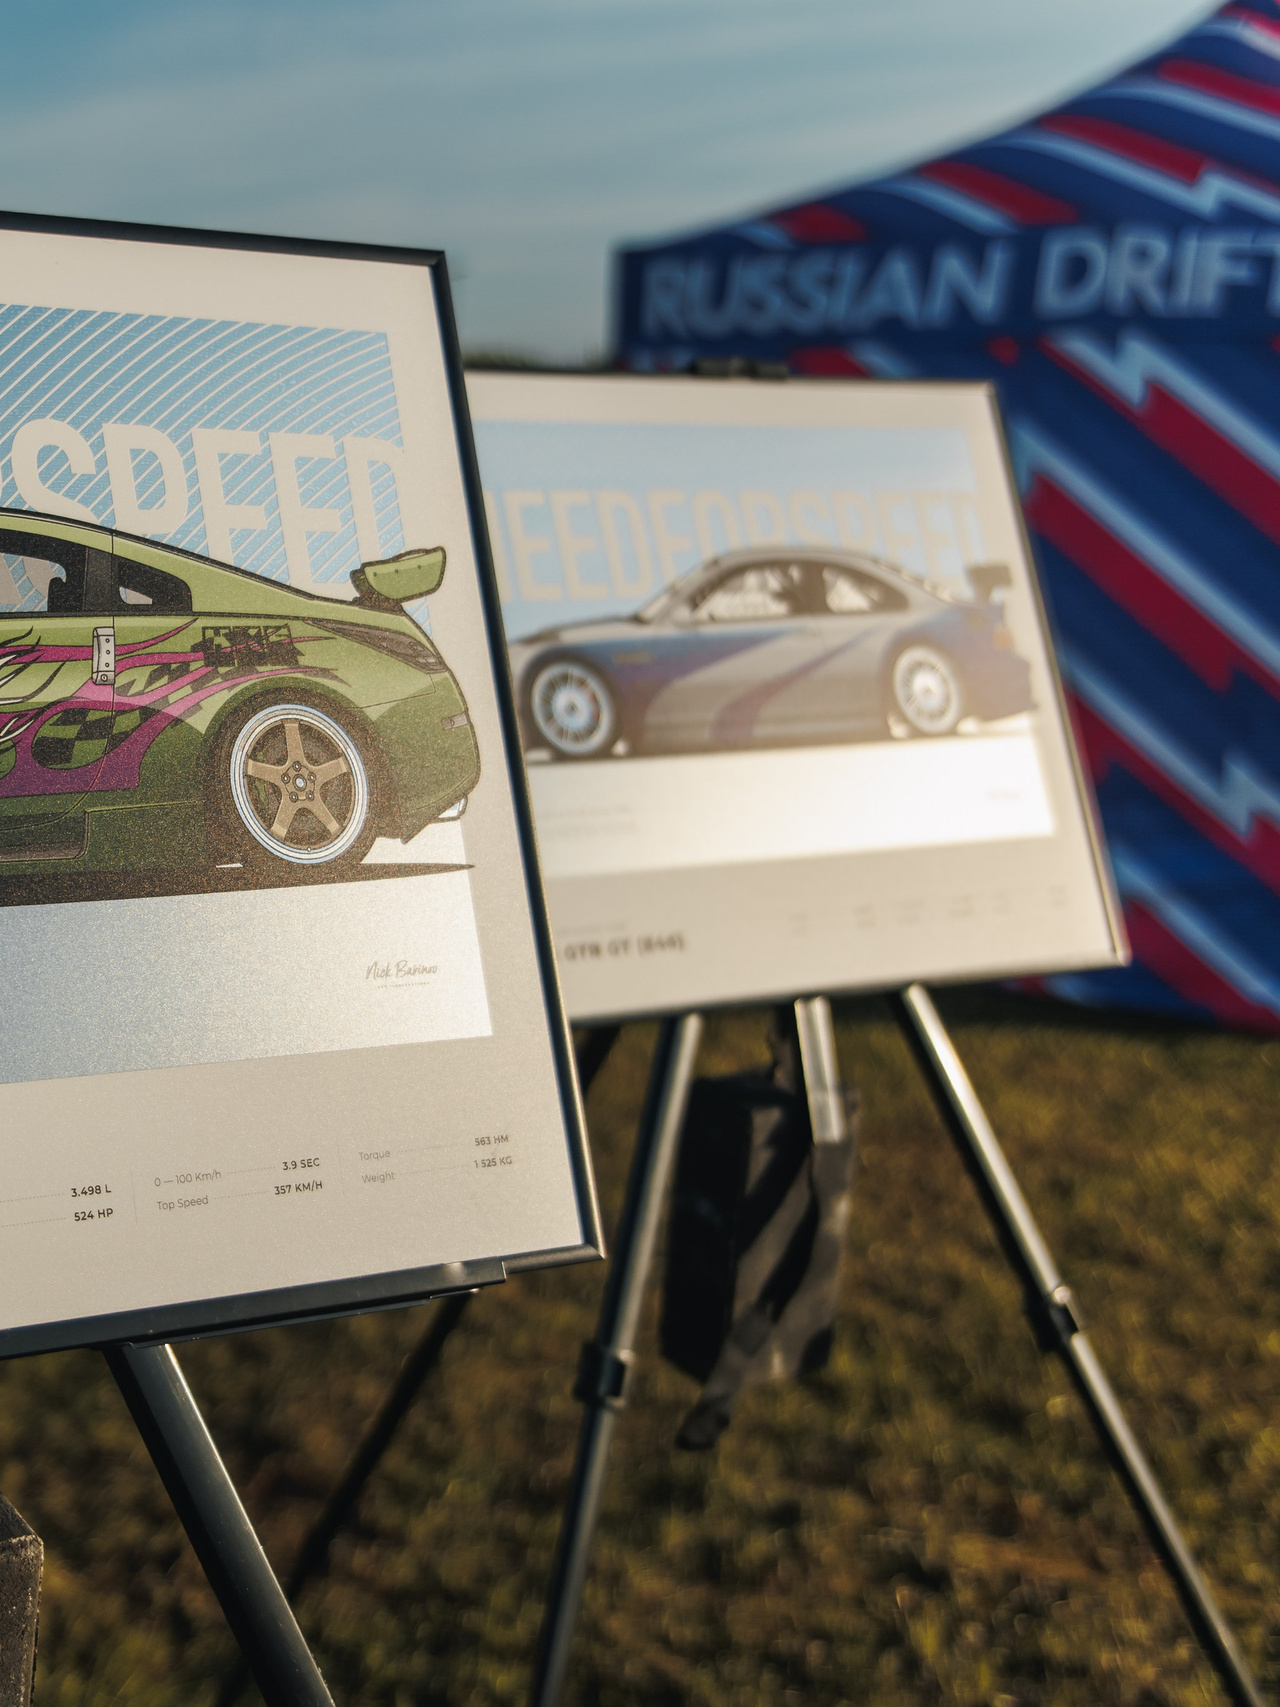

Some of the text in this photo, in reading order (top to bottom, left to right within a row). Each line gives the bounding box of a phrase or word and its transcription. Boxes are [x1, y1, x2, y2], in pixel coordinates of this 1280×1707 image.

[638, 240, 1012, 338] RUSSIAN
[365, 960, 392, 981] Nick
[358, 1150, 391, 1162] Torque
[474, 1136, 491, 1147] 563
[154, 1177, 161, 1187] 0
[175, 1173, 192, 1185] 100
[195, 1168, 222, 1183] Km/h
[282, 1160, 297, 1171] 3.9
[300, 1157, 320, 1169] SEC
[361, 1170, 395, 1184] Weight
[499, 1155, 513, 1166] KG
[71, 1185, 102, 1198] 3.498
[105, 1184, 112, 1194] L
[157, 1180, 323, 1212] Top Speed 357 KM/H
[74, 1209, 94, 1222] 524
[97, 1208, 114, 1219] HP
